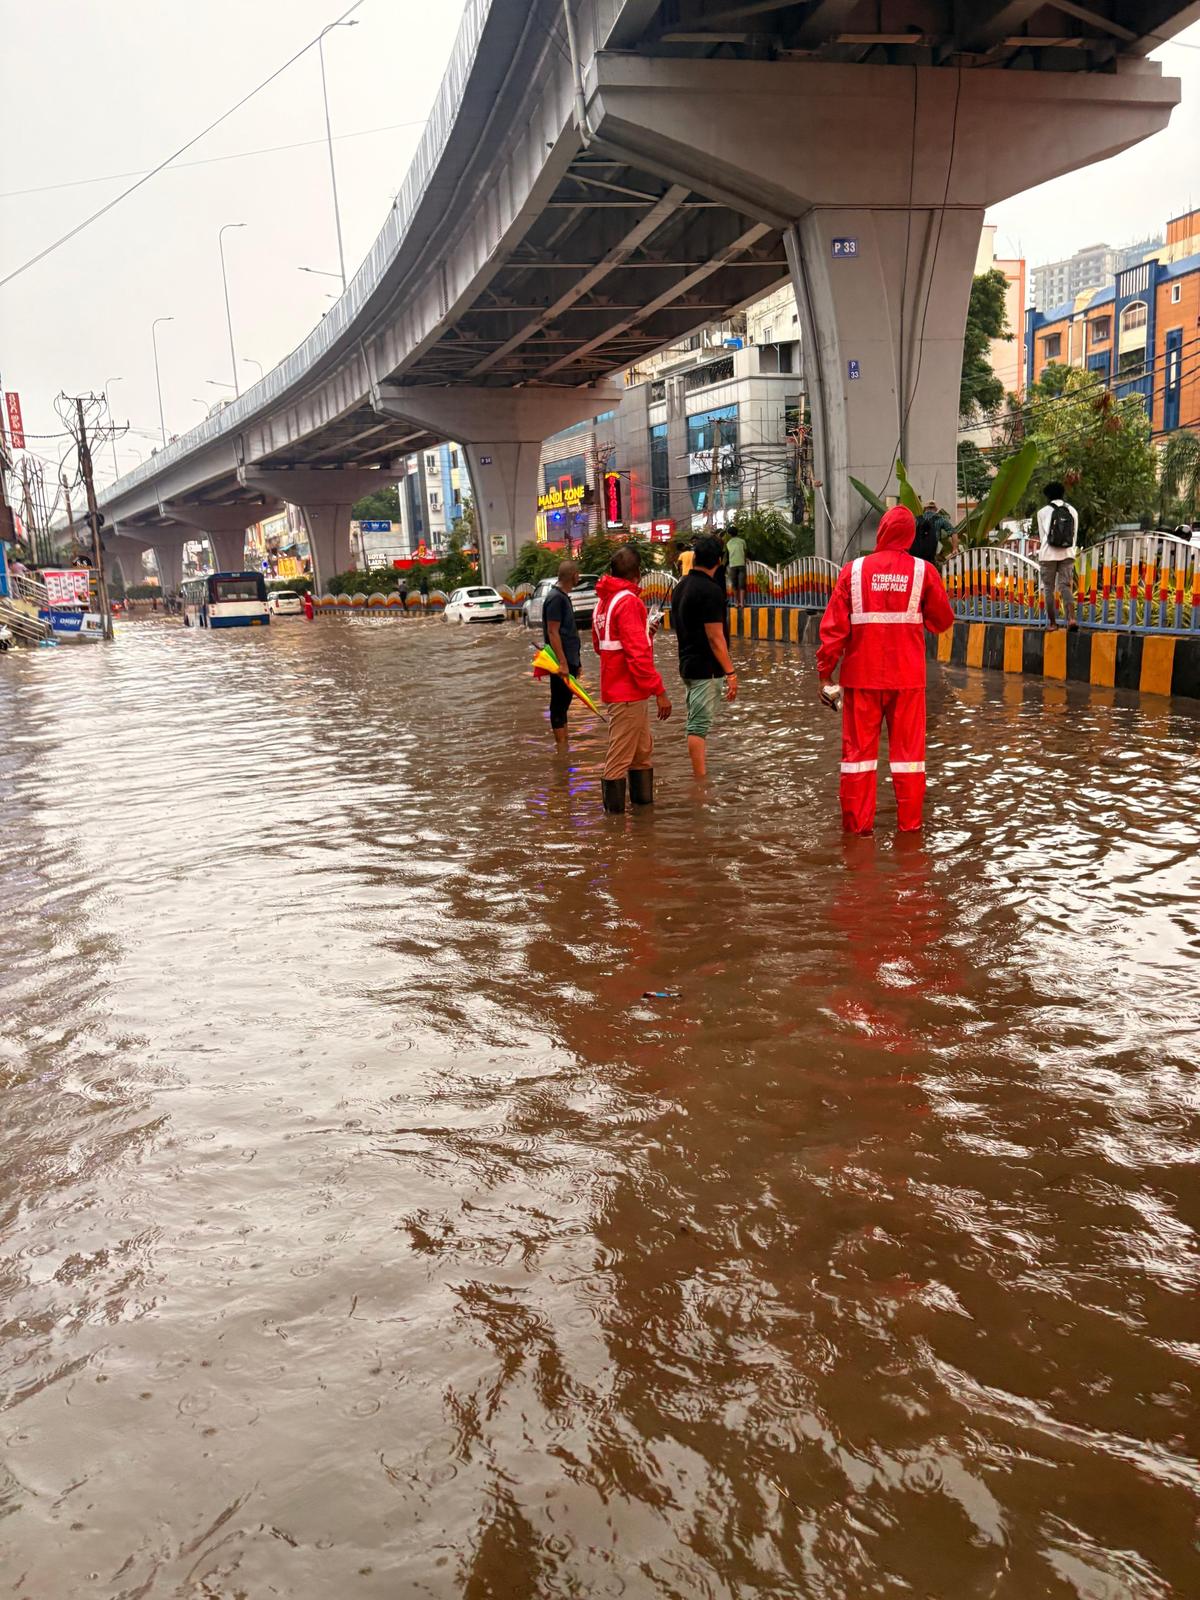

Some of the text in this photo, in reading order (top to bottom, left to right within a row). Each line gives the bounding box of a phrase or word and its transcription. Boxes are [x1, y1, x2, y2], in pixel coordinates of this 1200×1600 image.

[834, 241, 856, 253] P 33
[851, 361, 856, 369] P
[850, 370, 859, 379] 33
[538, 491, 563, 507] MANDI
[563, 485, 585, 500] ZONE
[872, 573, 909, 584] CYBERABAD
[871, 582, 908, 593] TRAFFIC POLICE
